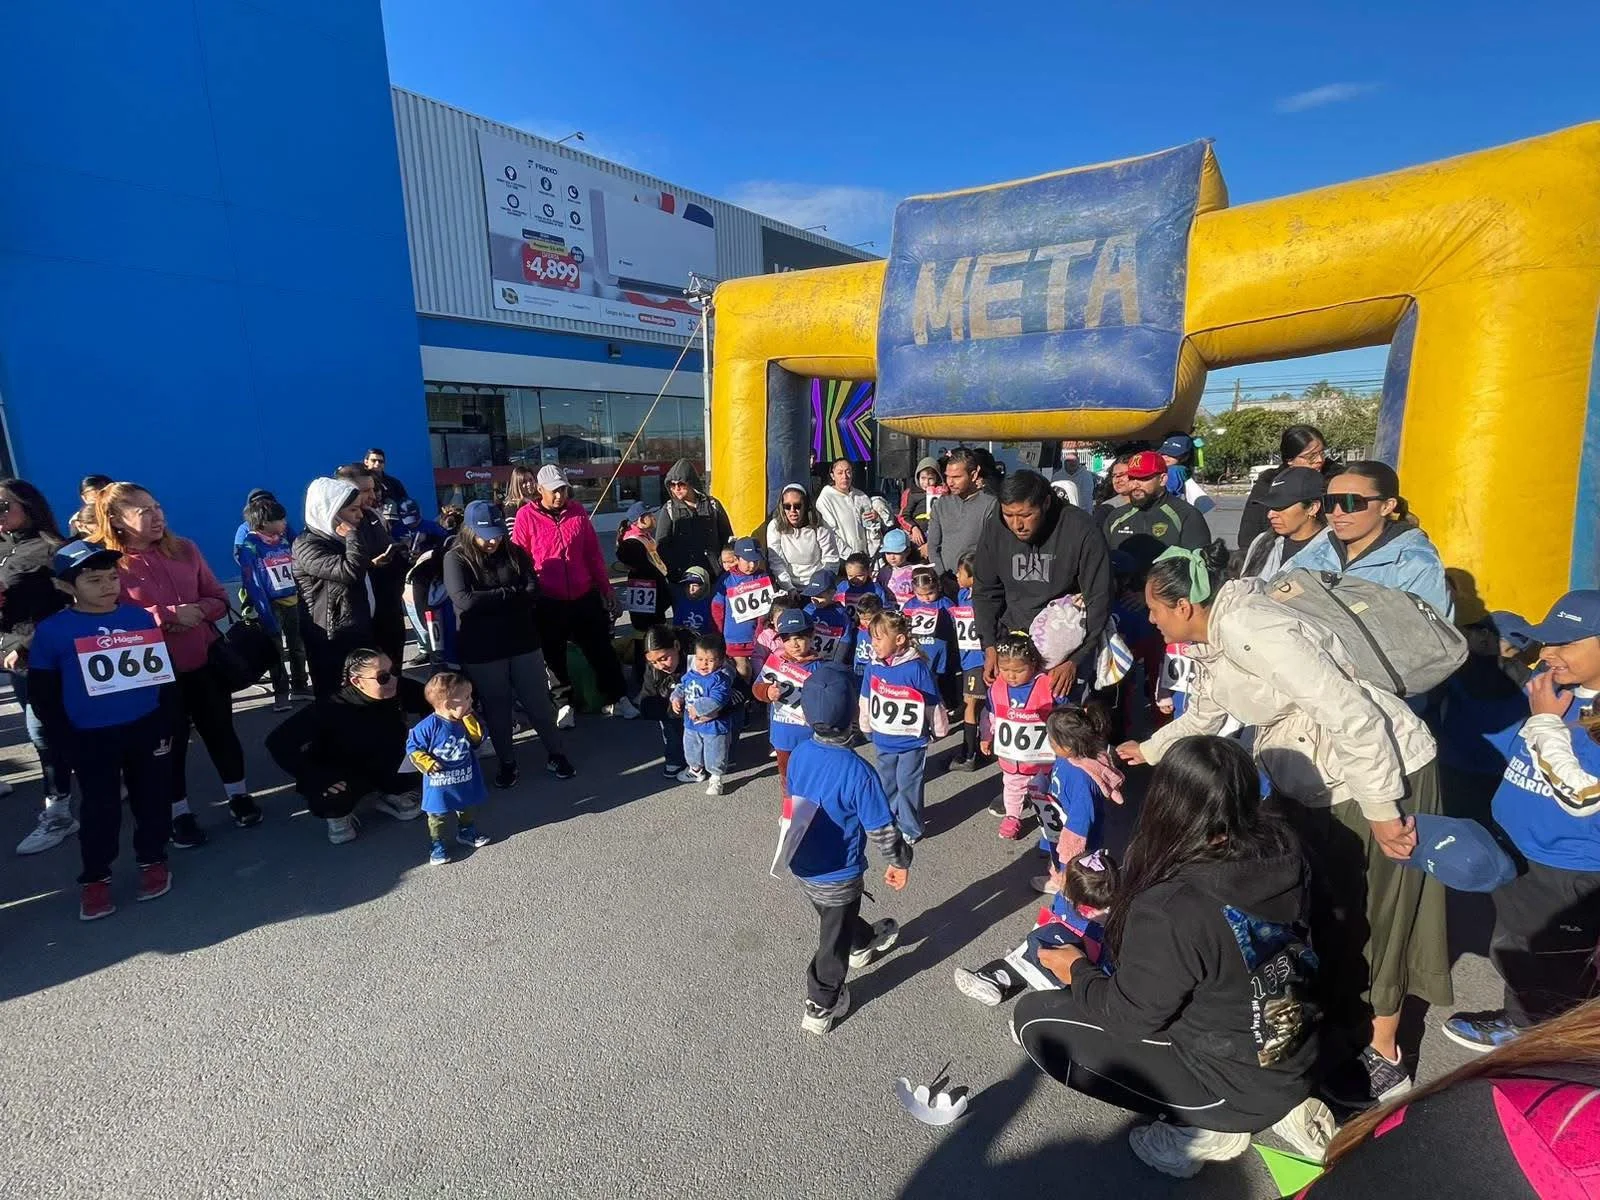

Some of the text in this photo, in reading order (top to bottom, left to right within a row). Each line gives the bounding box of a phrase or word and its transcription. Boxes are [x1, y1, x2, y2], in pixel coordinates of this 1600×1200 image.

[526, 256, 579, 283] $4,899
[912, 232, 1142, 345] META
[1012, 553, 1053, 583] CAT
[630, 589, 655, 606] 132
[734, 589, 772, 614] 064
[88, 647, 164, 682] 066
[871, 694, 919, 726] 095
[998, 722, 1049, 751] 067
